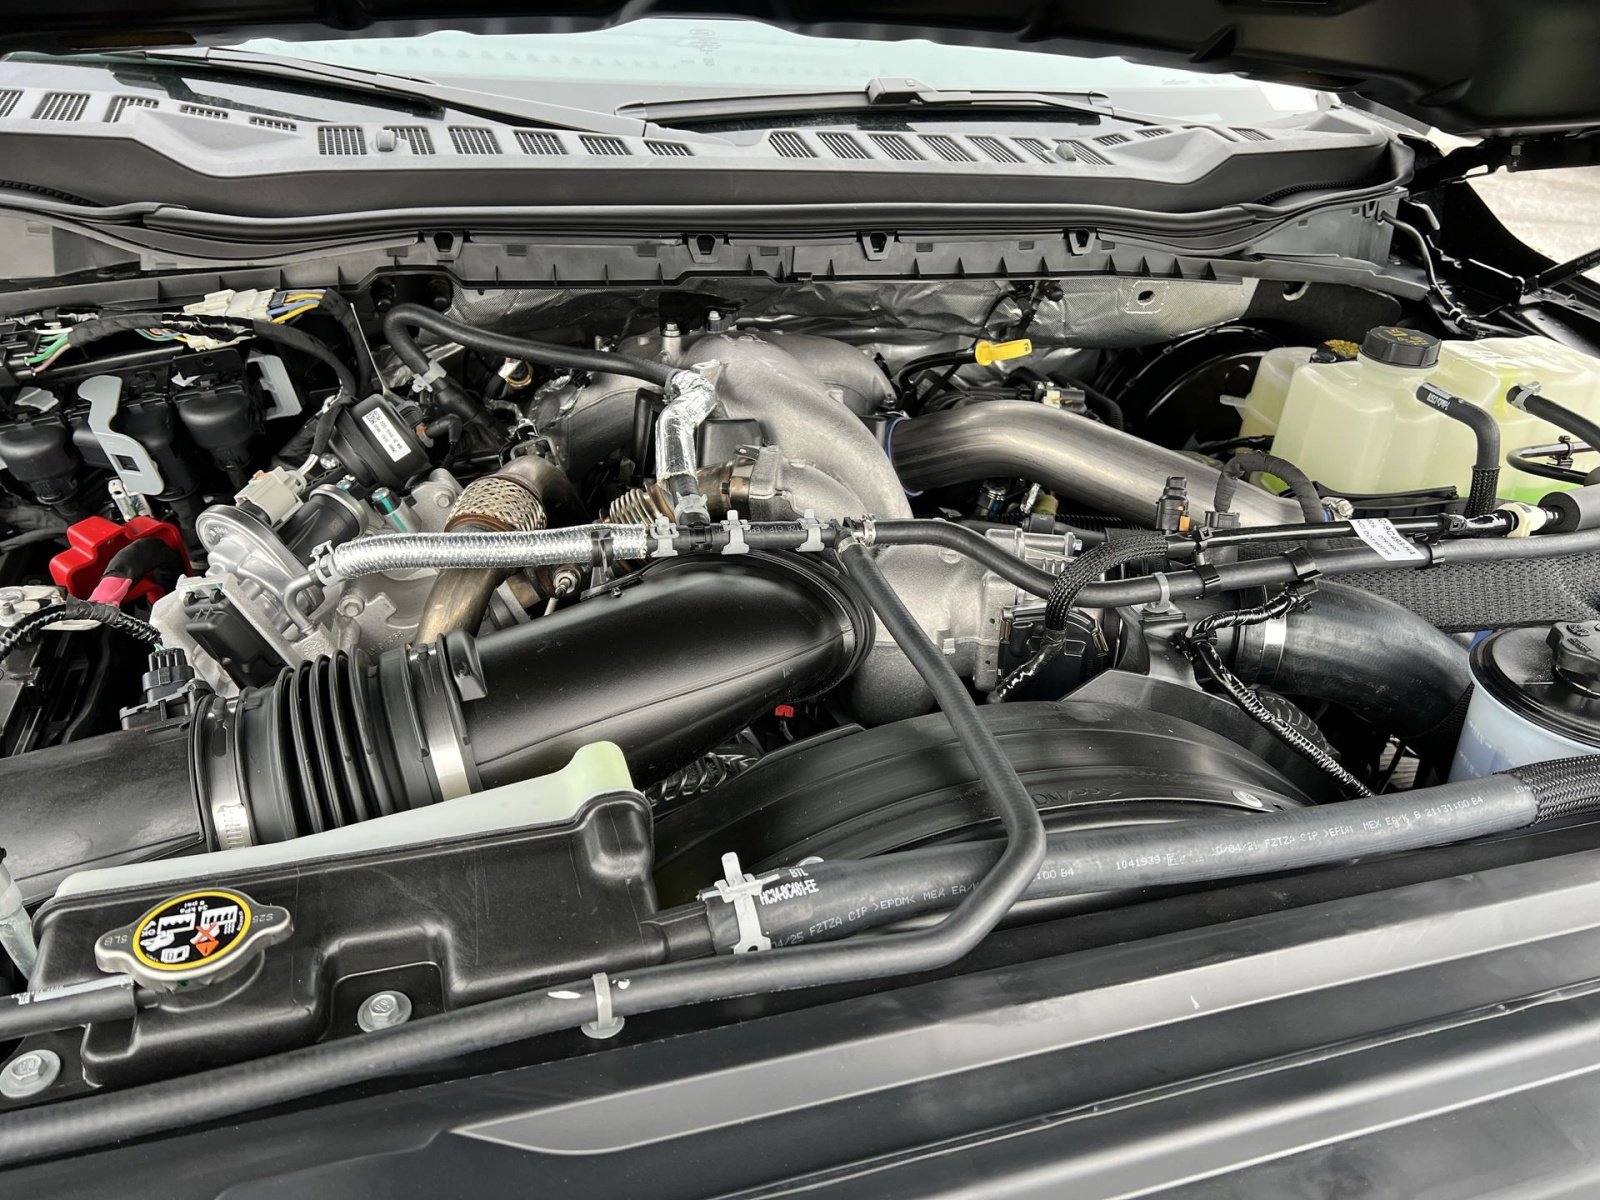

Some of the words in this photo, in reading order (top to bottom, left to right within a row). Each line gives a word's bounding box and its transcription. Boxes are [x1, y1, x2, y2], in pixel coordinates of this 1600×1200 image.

[1115, 855, 1161, 870] 1041939
[1362, 819, 1382, 831] MEX
[1426, 799, 1469, 817] 21:31:00
[788, 867, 809, 878] BTL
[809, 916, 843, 937] FZTZA
[848, 906, 868, 922] CIP
[923, 889, 945, 901] MEX
